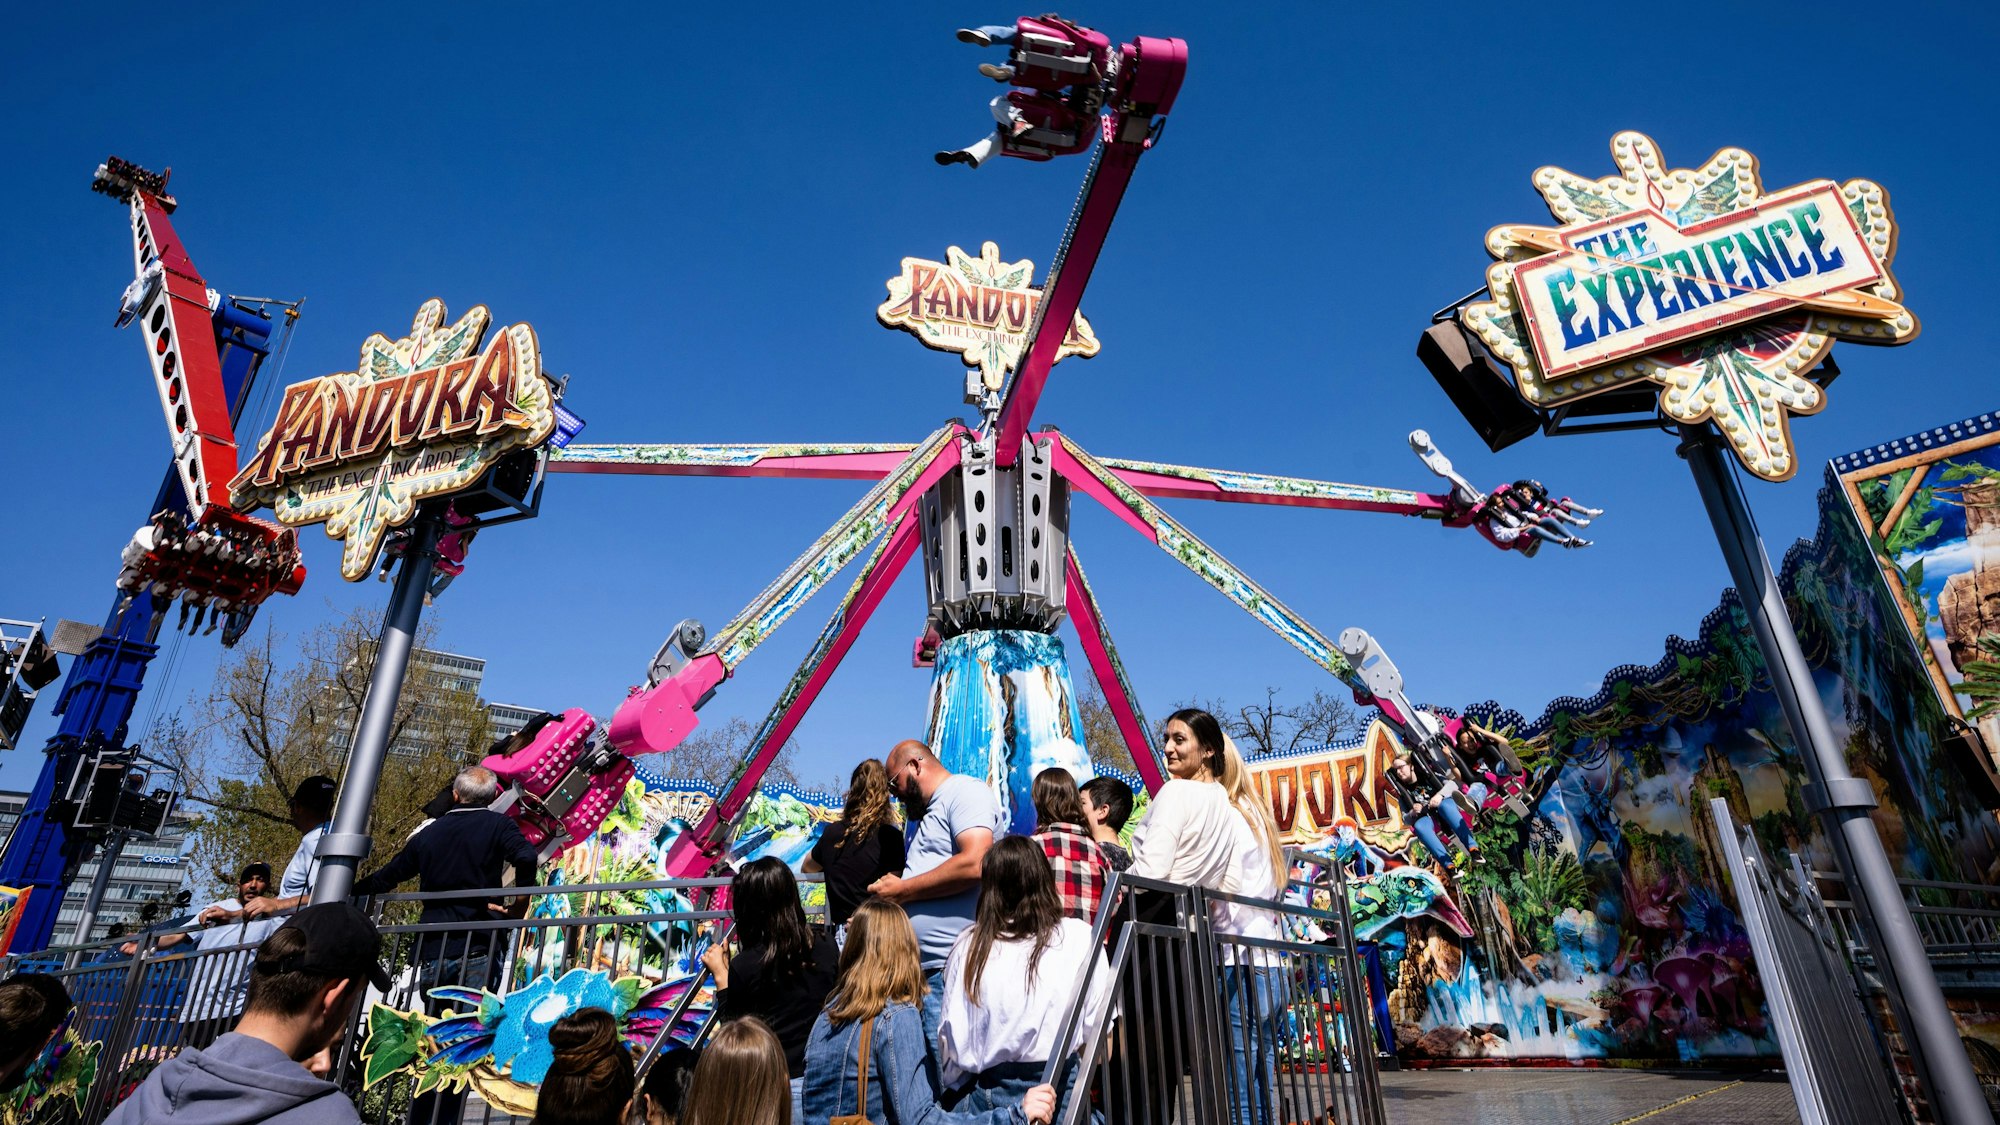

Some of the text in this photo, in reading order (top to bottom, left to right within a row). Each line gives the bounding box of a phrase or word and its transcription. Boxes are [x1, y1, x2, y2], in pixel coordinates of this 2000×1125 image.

[1543, 202, 1846, 351] EXPERIENCE
[1573, 220, 1658, 269] THE
[888, 264, 1094, 349] PANDO
[941, 324, 964, 337] THE
[227, 328, 532, 488] PANDORA
[307, 446, 464, 499] THE EXCITING RIDE
